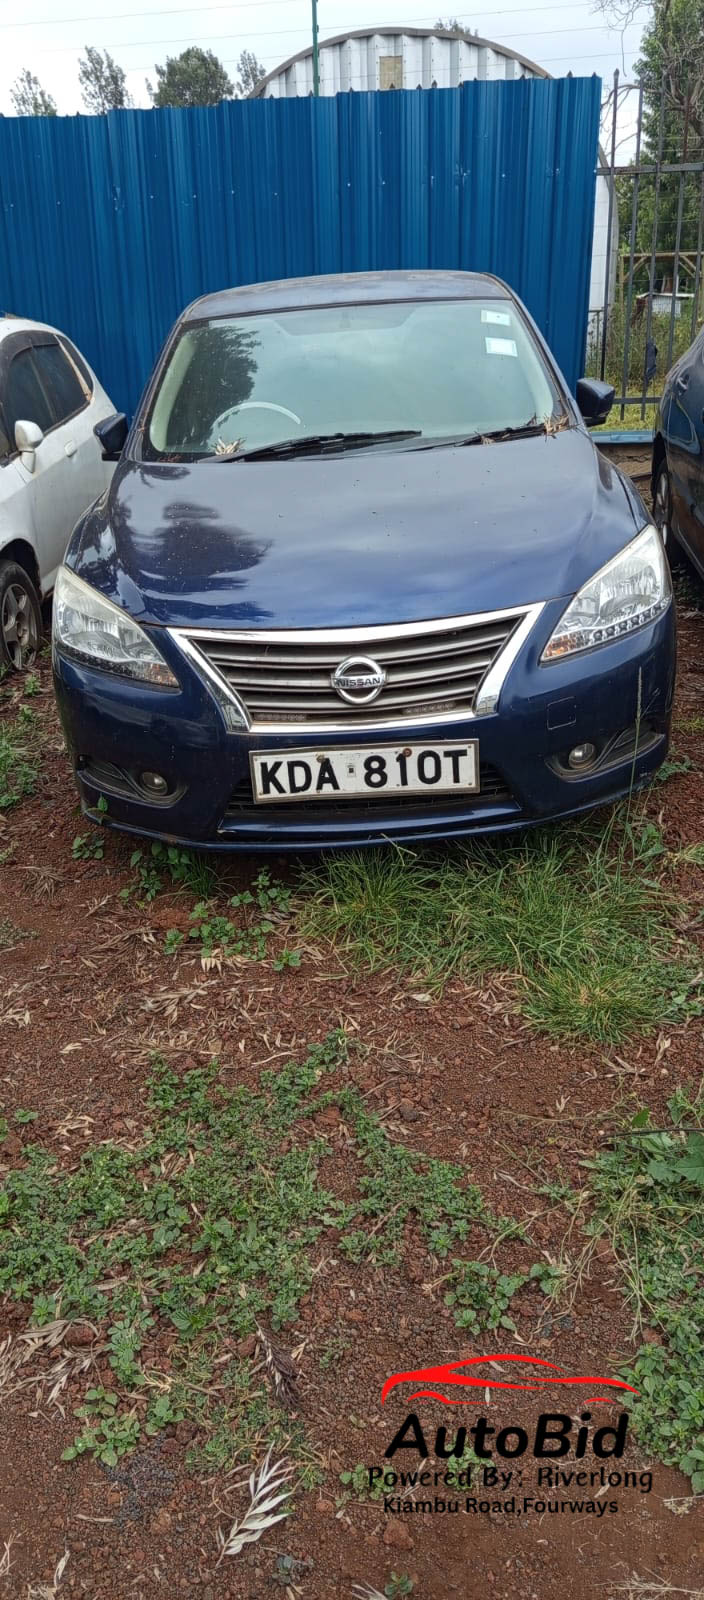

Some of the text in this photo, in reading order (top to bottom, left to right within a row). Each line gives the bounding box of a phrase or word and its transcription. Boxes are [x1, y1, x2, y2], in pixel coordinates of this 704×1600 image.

[335, 676, 381, 688] NISSAN
[260, 749, 468, 795] KDA 810T
